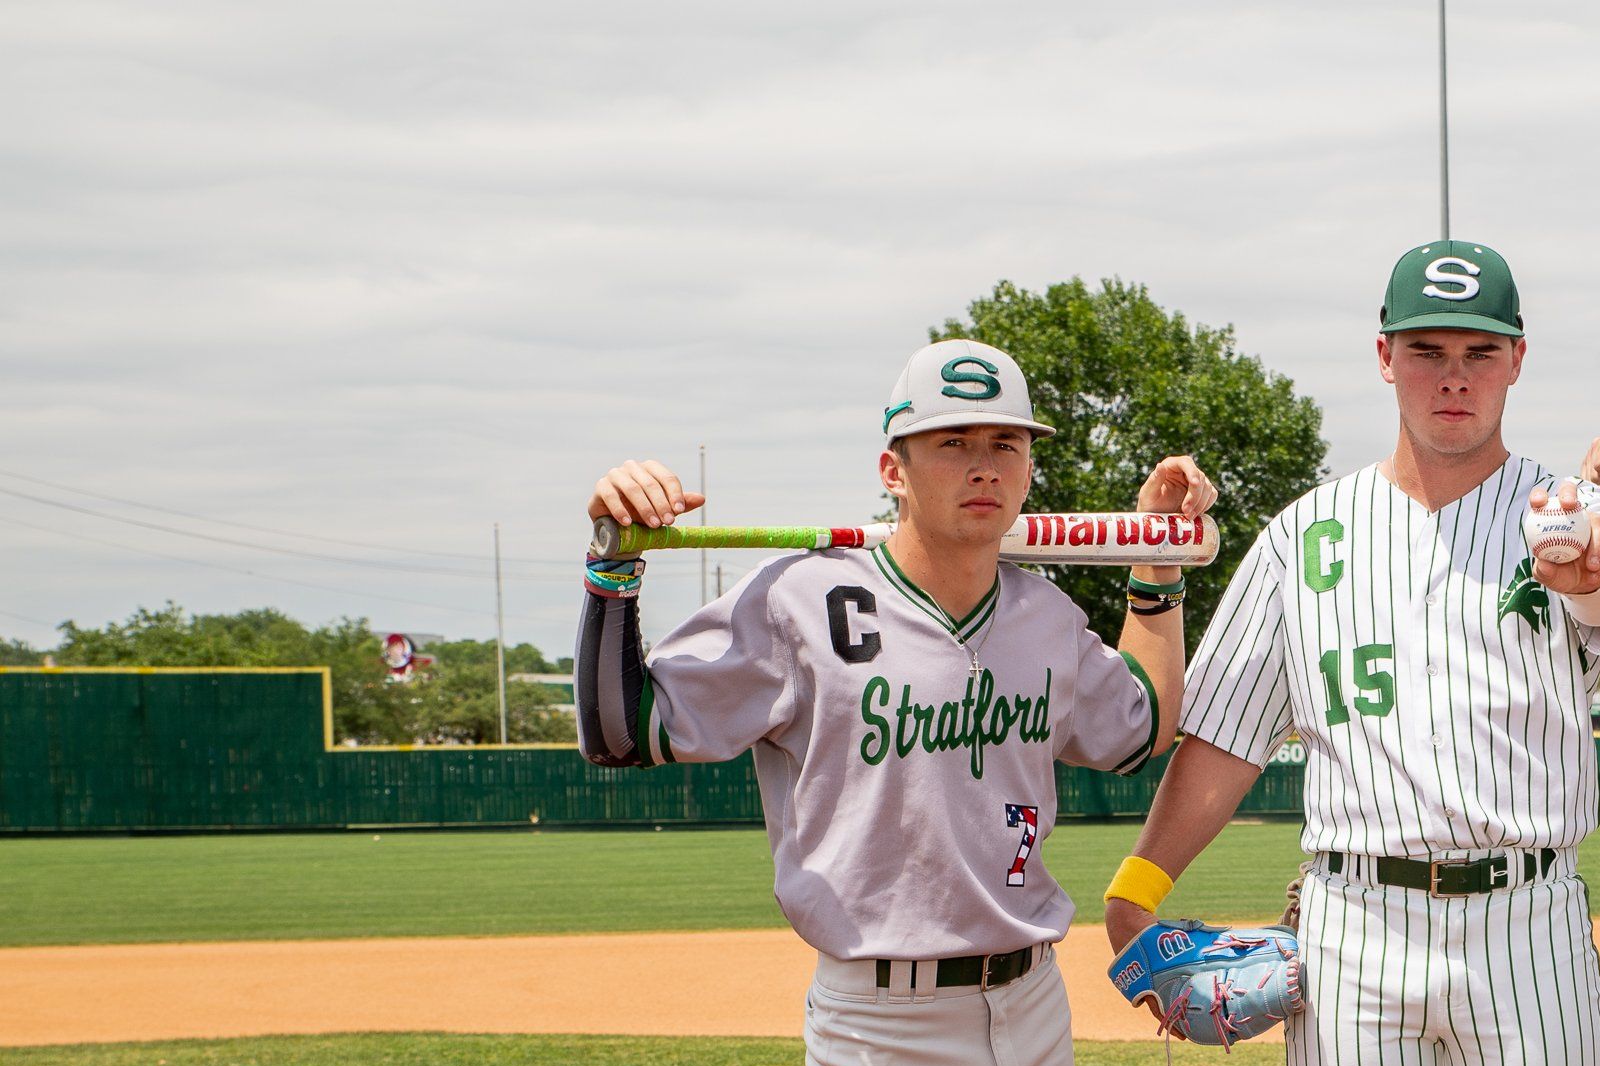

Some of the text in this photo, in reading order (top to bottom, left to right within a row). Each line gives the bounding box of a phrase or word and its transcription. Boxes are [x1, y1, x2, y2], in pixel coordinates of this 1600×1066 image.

[1422, 256, 1481, 301] S
[940, 356, 1002, 402] S
[1025, 514, 1204, 547] marucci
[1303, 518, 1345, 593] C
[826, 585, 883, 664] C
[1319, 643, 1395, 727] 15
[860, 667, 1052, 780] Stratford
[1269, 742, 1307, 763] 60
[1005, 803, 1039, 887] 7
